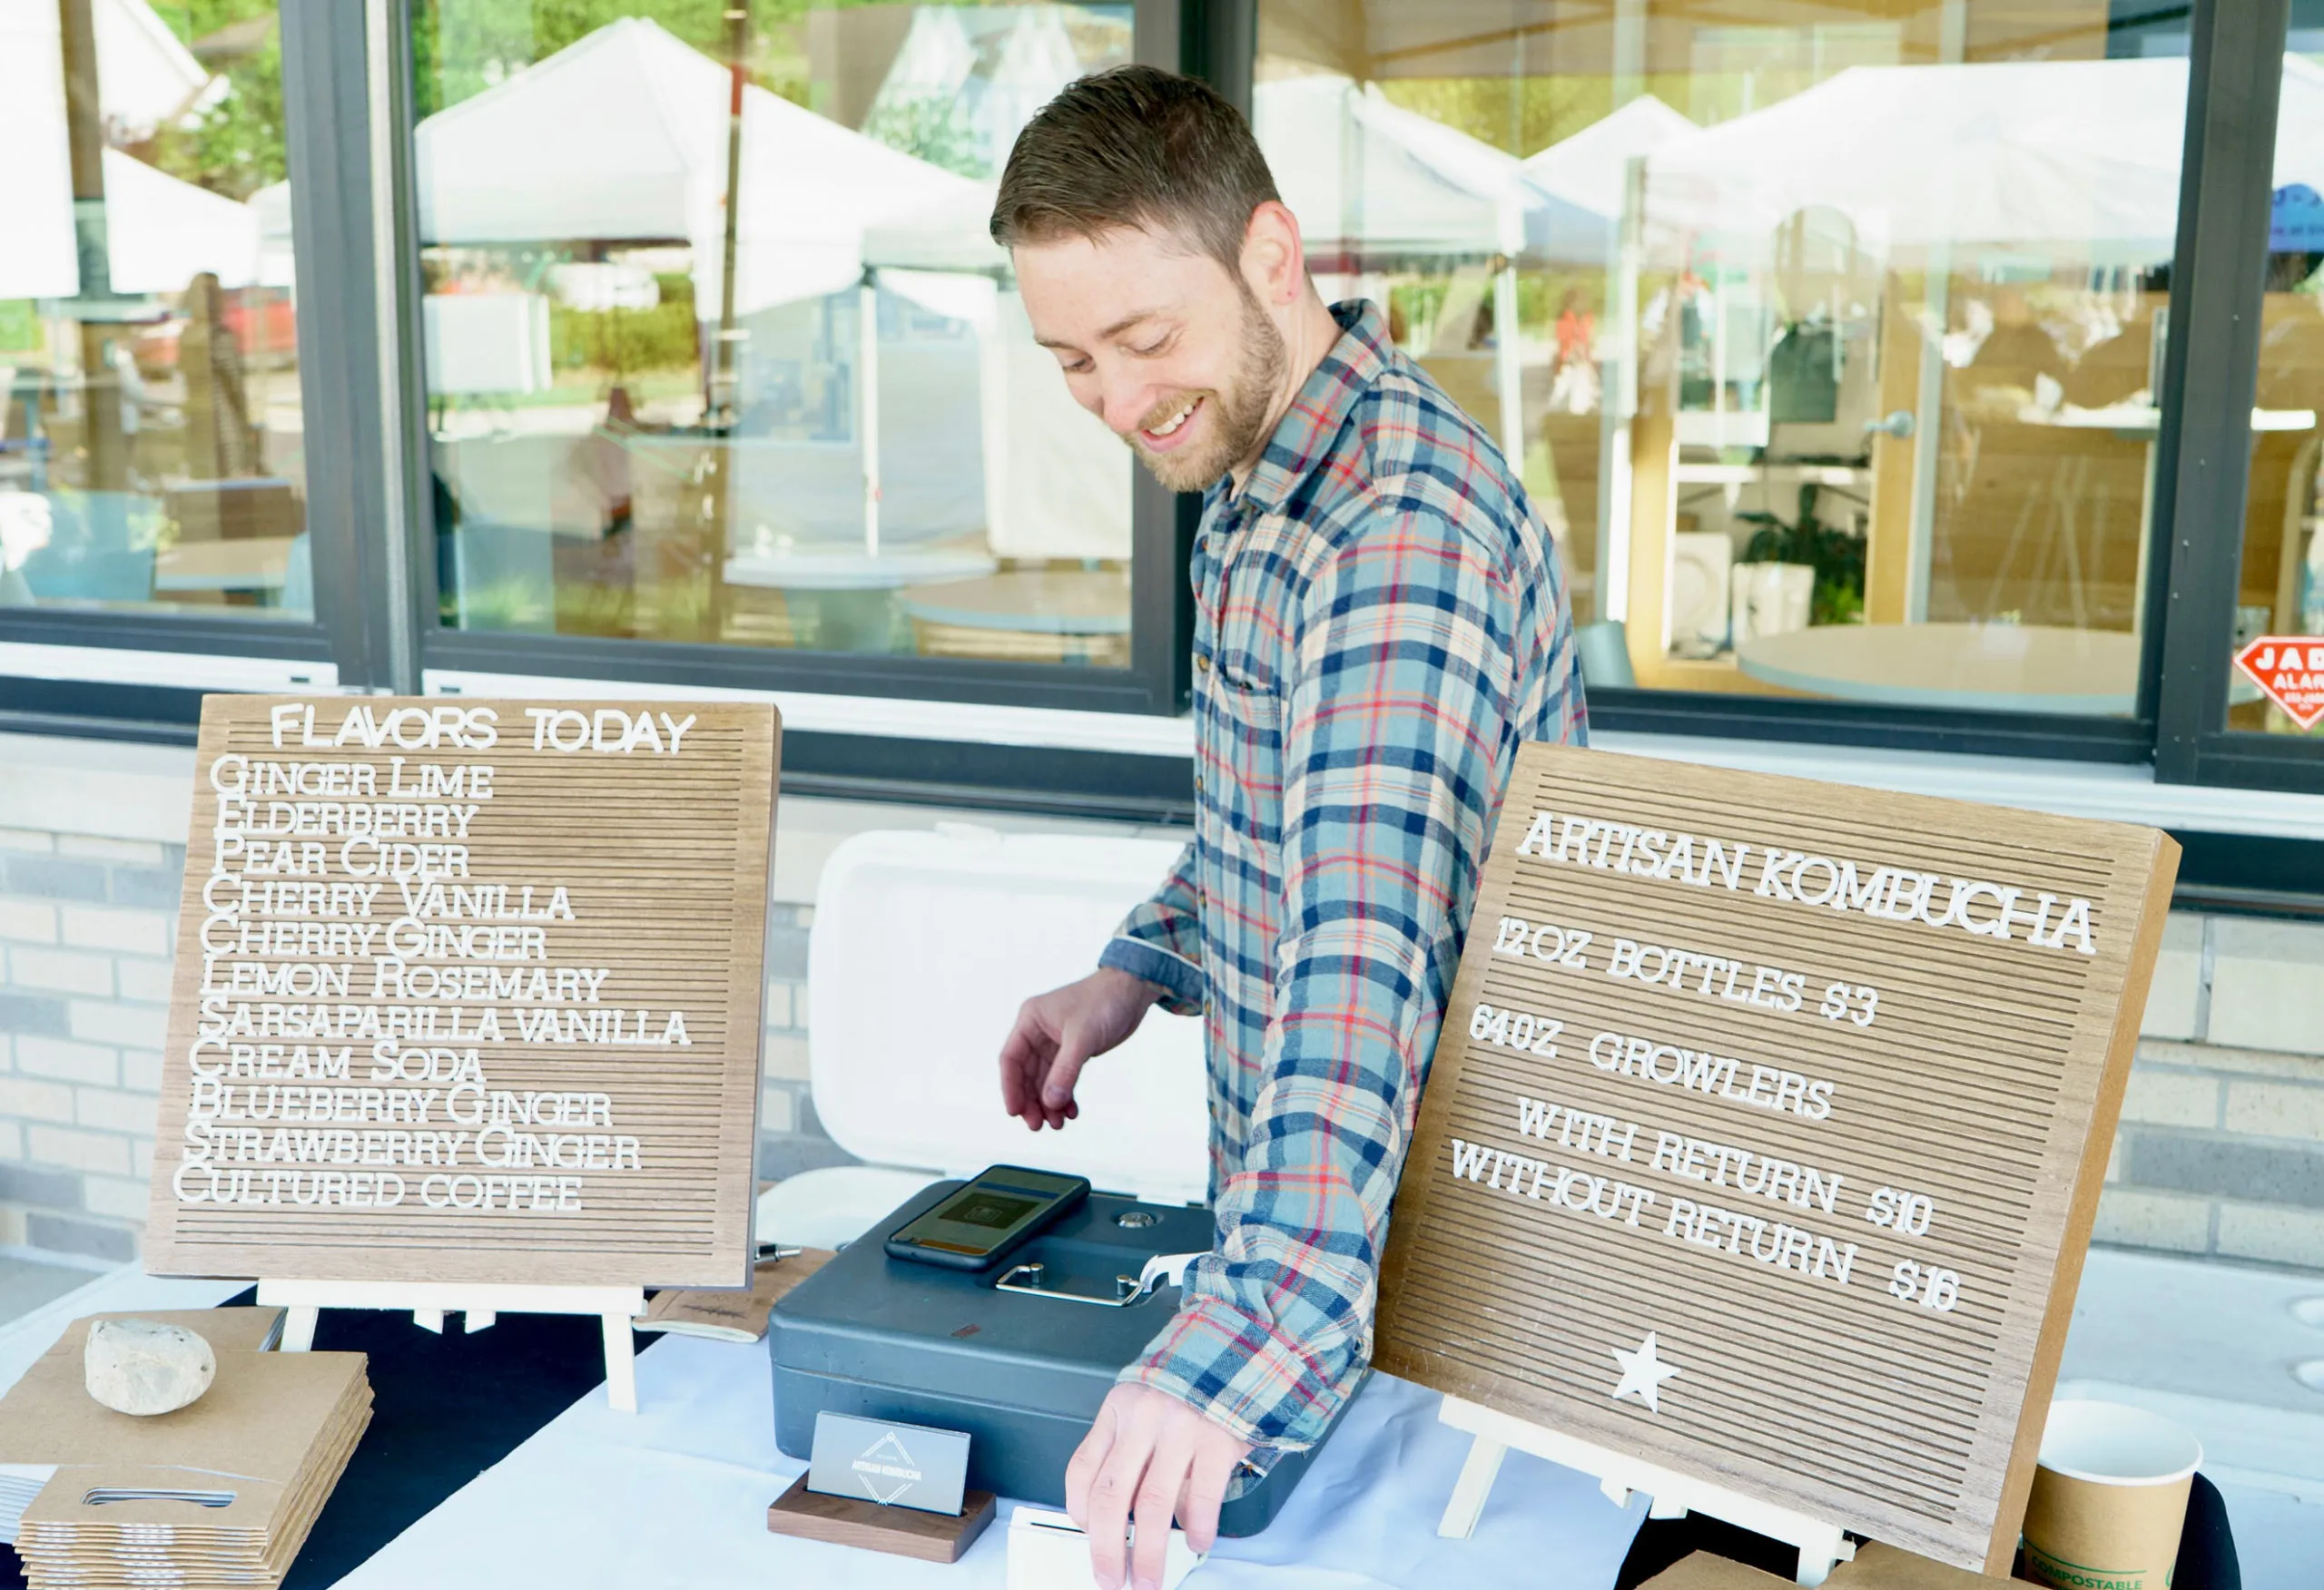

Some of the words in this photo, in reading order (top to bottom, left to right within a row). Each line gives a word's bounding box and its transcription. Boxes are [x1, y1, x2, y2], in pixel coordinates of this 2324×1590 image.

[271, 703, 498, 751] FLAVORS
[525, 707, 697, 755] TODAY
[210, 753, 377, 797] GINGER
[387, 755, 495, 800] LIME
[213, 793, 480, 839] ELDERBERRY
[211, 833, 328, 876] PEAR
[340, 834, 470, 878] CIDER
[202, 873, 382, 918] CHERRY
[398, 876, 576, 922] VANILLA
[1515, 810, 1751, 891] ARTISAN
[1753, 845, 2097, 955] KOMBUCHA
[199, 913, 382, 957] CHERRY
[385, 915, 547, 960] GINGER
[199, 956, 351, 998] LEMON
[370, 957, 610, 1004] ROSEMARY
[1605, 937, 1806, 1014] BOTTLES
[1819, 980, 1879, 1028] $3
[197, 995, 506, 1043] SARSAPARILLA
[512, 1006, 692, 1045] VANILLA
[188, 1036, 352, 1080] CREAM
[370, 1038, 487, 1083] SODA
[1588, 1031, 1836, 1121] GROWLERS
[187, 1075, 439, 1124] BLUEBERRY
[446, 1082, 614, 1128] GINGER
[182, 1117, 468, 1167] STRAWBERRY
[474, 1124, 642, 1171] GINGER
[1516, 1096, 1640, 1163] WITH
[1649, 1130, 1844, 1215] RETURN
[1865, 1186, 1935, 1237] $10
[172, 1159, 406, 1208] CULTURED
[419, 1173, 583, 1212] COFFEE
[1450, 1138, 1655, 1227] WITHOUT
[1662, 1196, 1859, 1285] RETURN
[1886, 1258, 1961, 1312] $16
[2032, 1555, 2143, 1590] COMPOSTABLE
